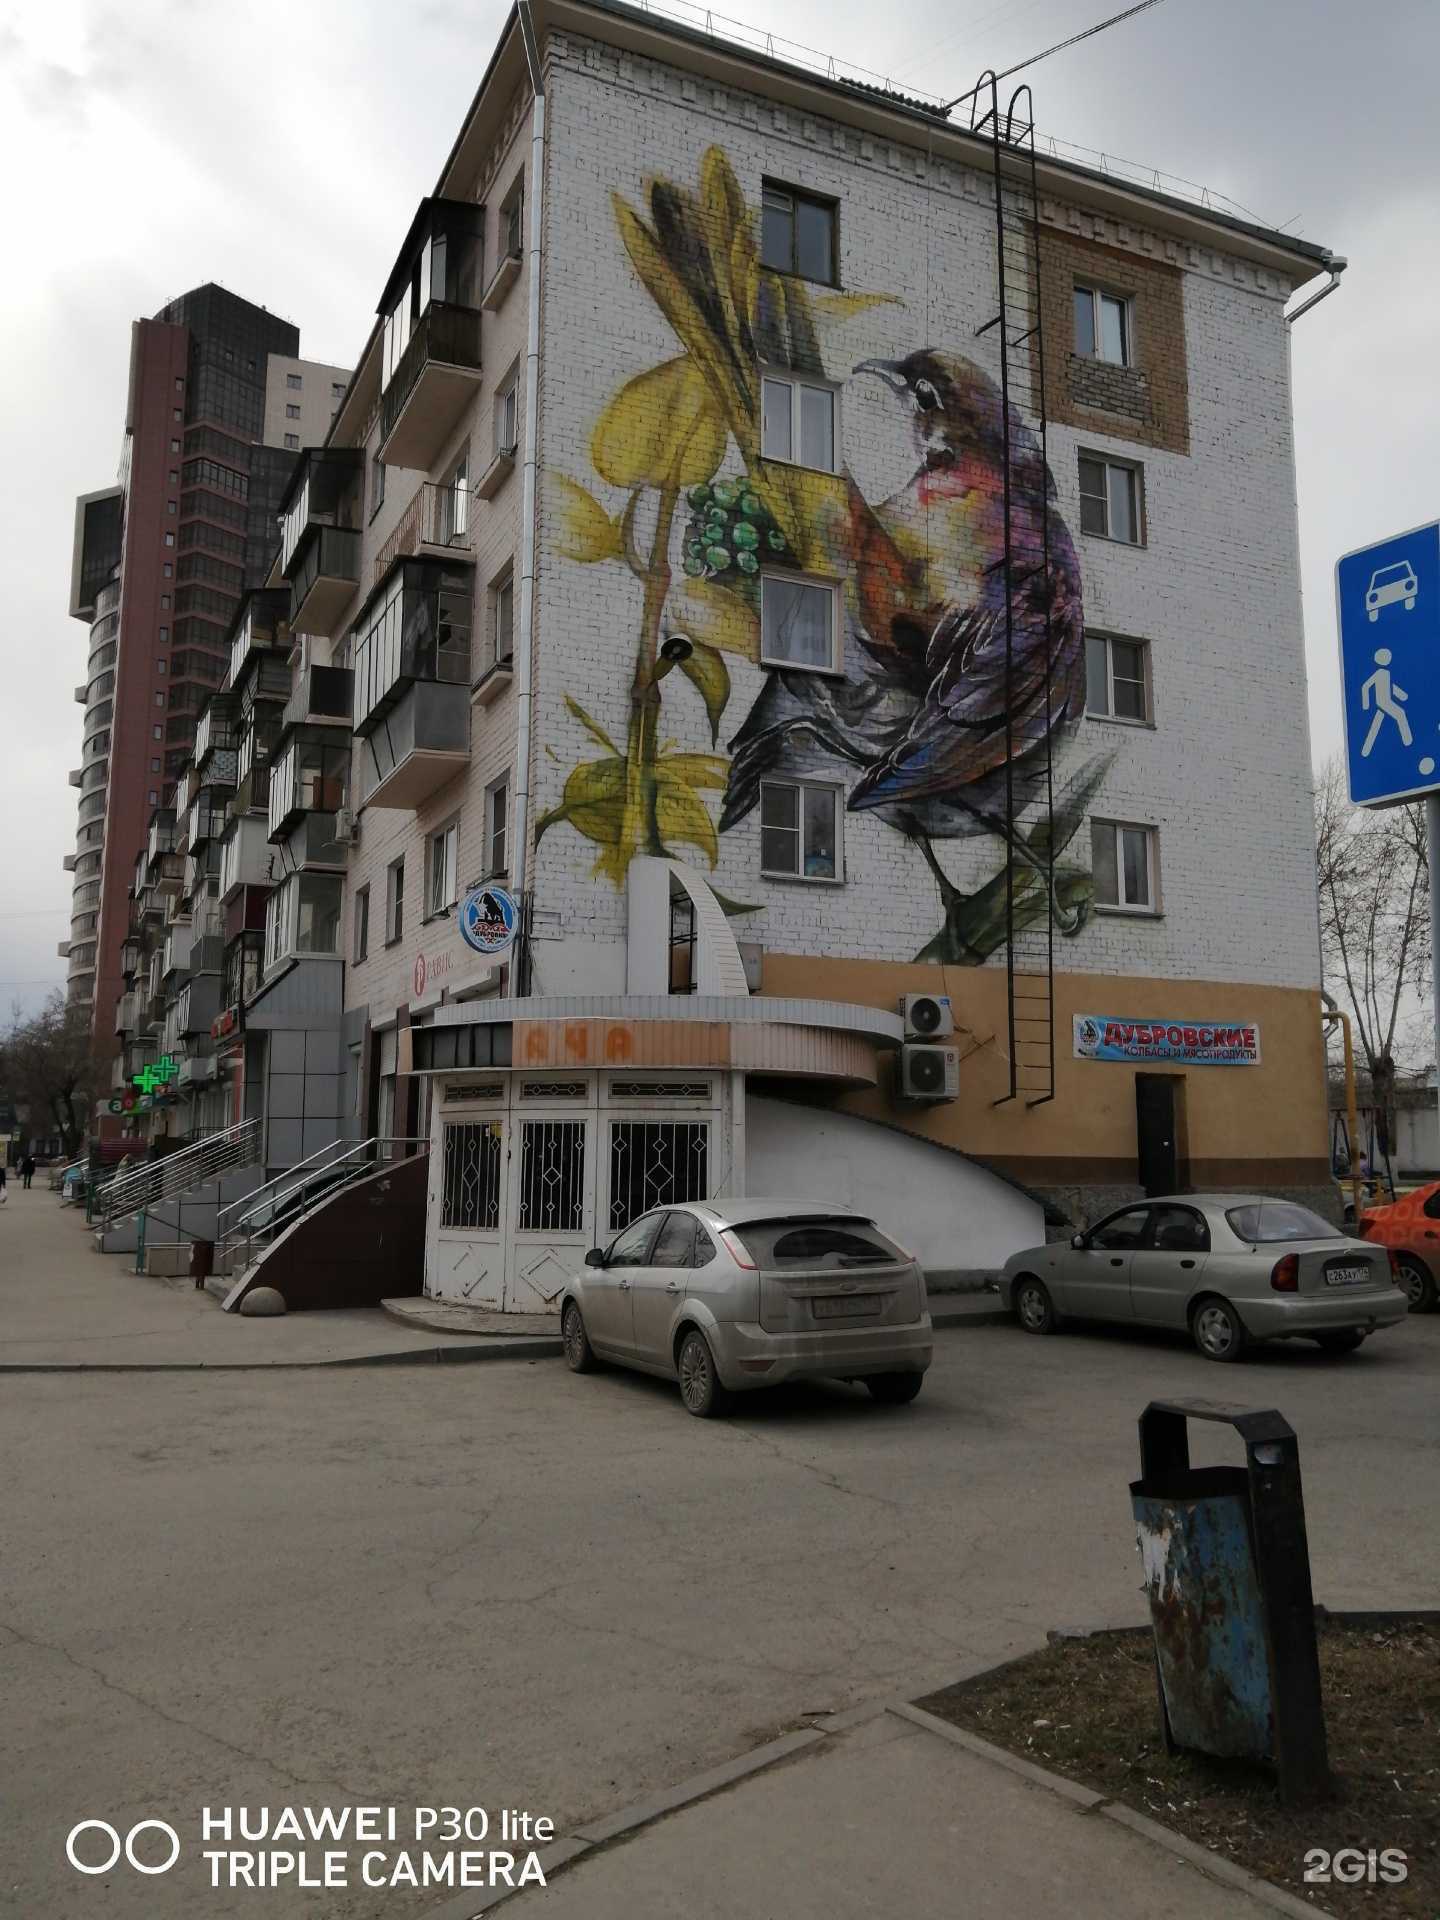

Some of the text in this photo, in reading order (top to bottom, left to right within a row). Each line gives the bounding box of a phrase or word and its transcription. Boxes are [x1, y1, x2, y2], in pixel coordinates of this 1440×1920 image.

[1104, 1023, 1256, 1048] ДУБРОВСКИЕ
[1123, 1046, 1257, 1060] КОЛБАСЫ И МЯСОПРОДУКТЫ
